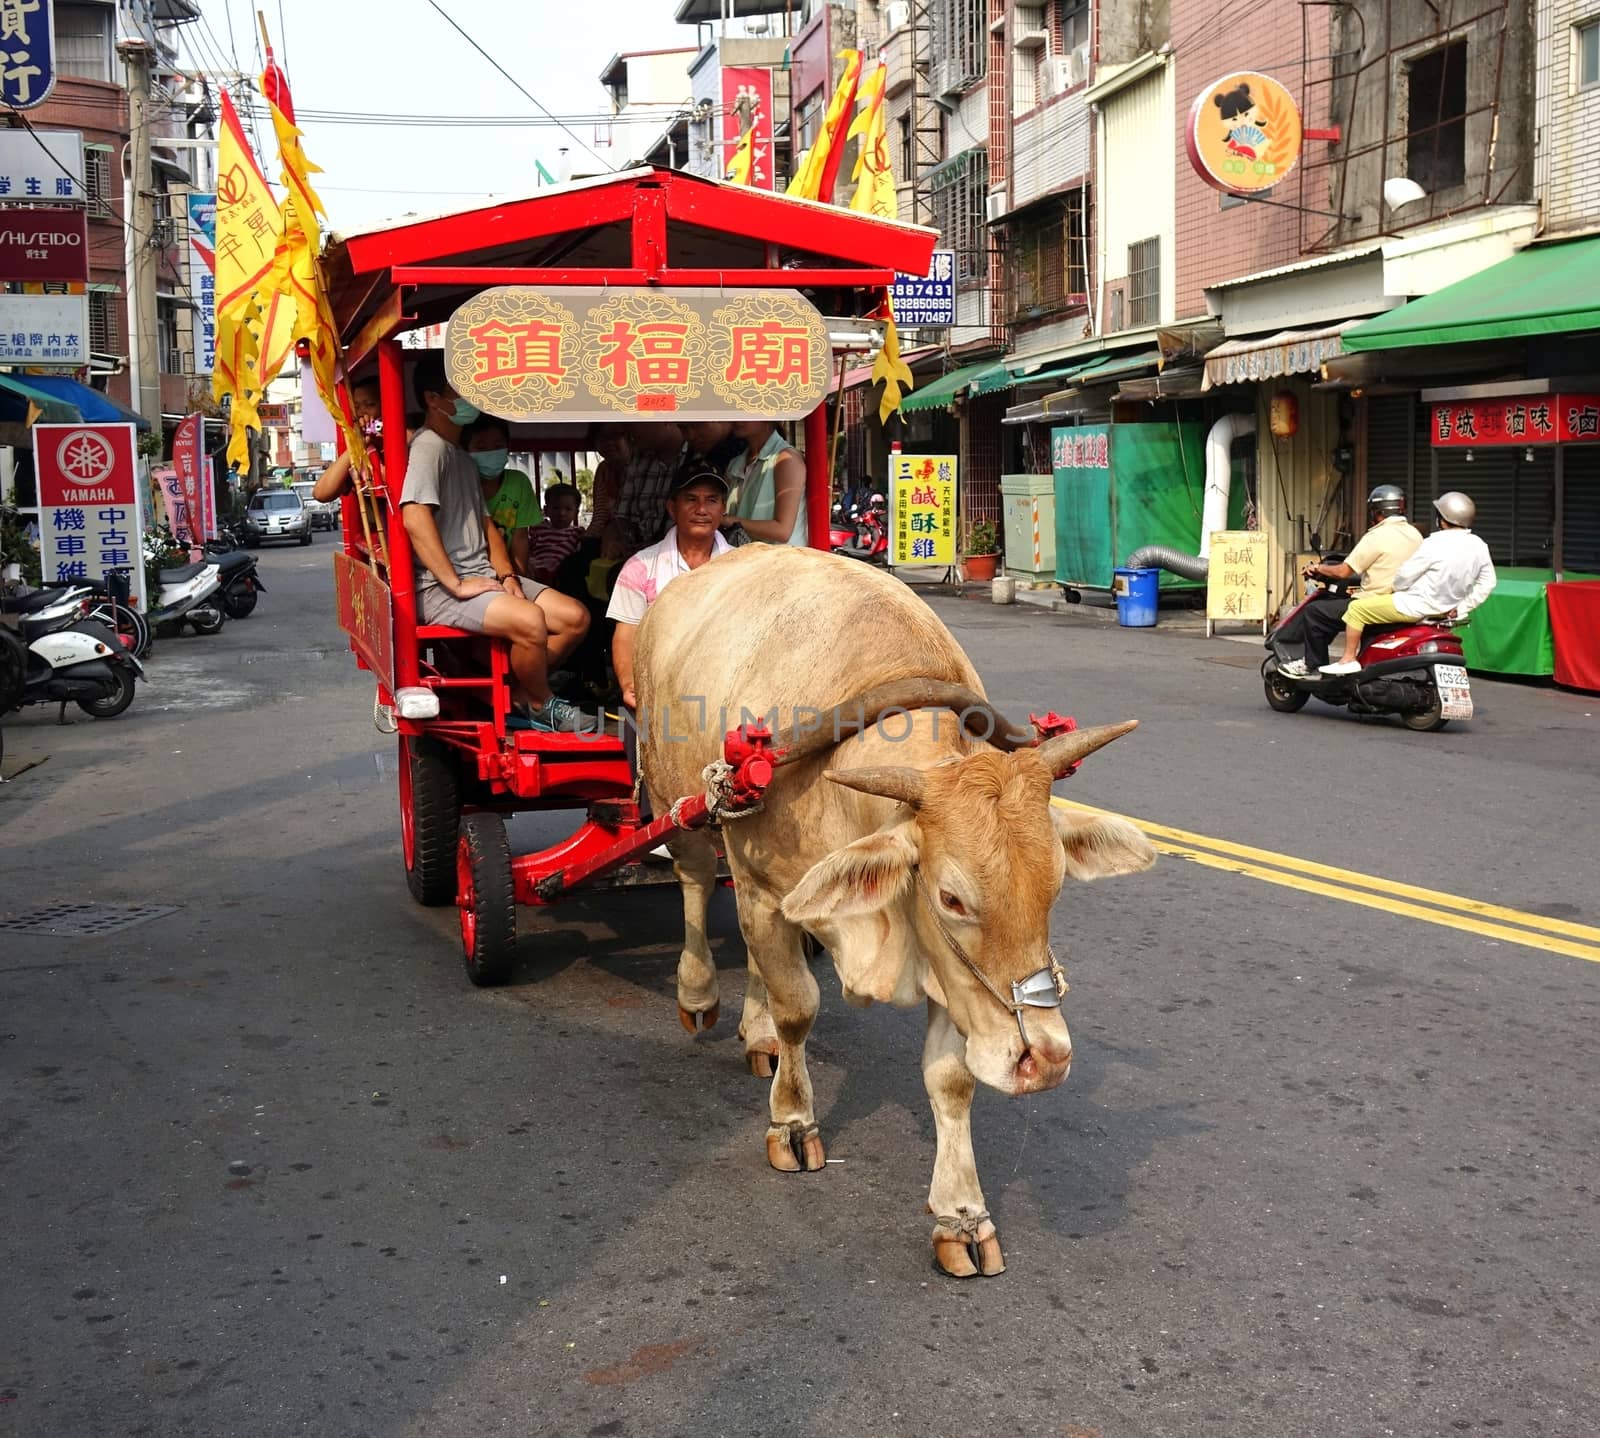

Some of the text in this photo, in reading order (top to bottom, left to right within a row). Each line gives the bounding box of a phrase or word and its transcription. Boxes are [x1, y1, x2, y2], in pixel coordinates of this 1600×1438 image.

[0, 230, 80, 246] SHISEIDO
[467, 318, 811, 387] 鎮福廟
[62, 488, 115, 502] YAMAHA
[911, 485, 940, 559] 鹹酥雞
